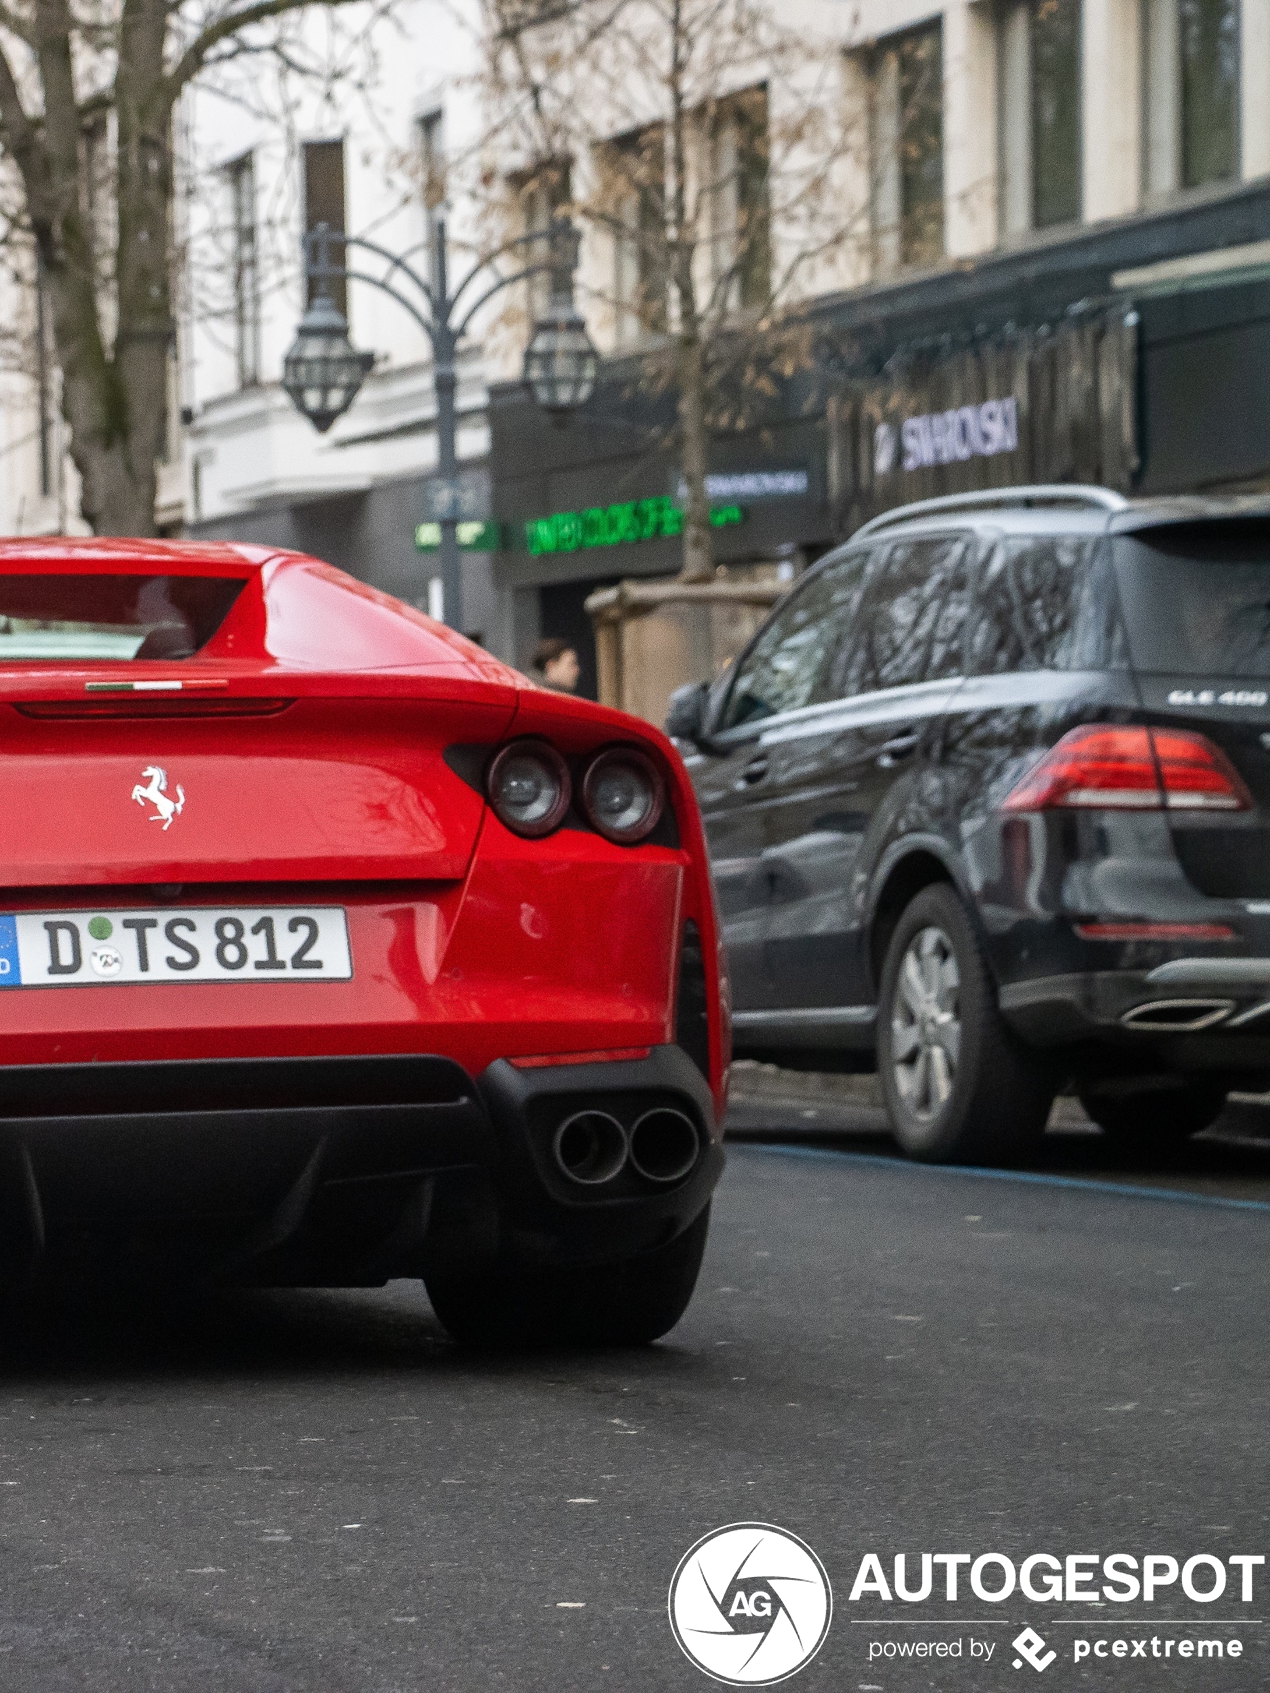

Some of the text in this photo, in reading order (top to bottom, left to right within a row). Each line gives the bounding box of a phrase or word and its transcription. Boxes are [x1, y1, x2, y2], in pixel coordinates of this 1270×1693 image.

[1167, 690, 1268, 707] GLE 400
[44, 920, 82, 975] D
